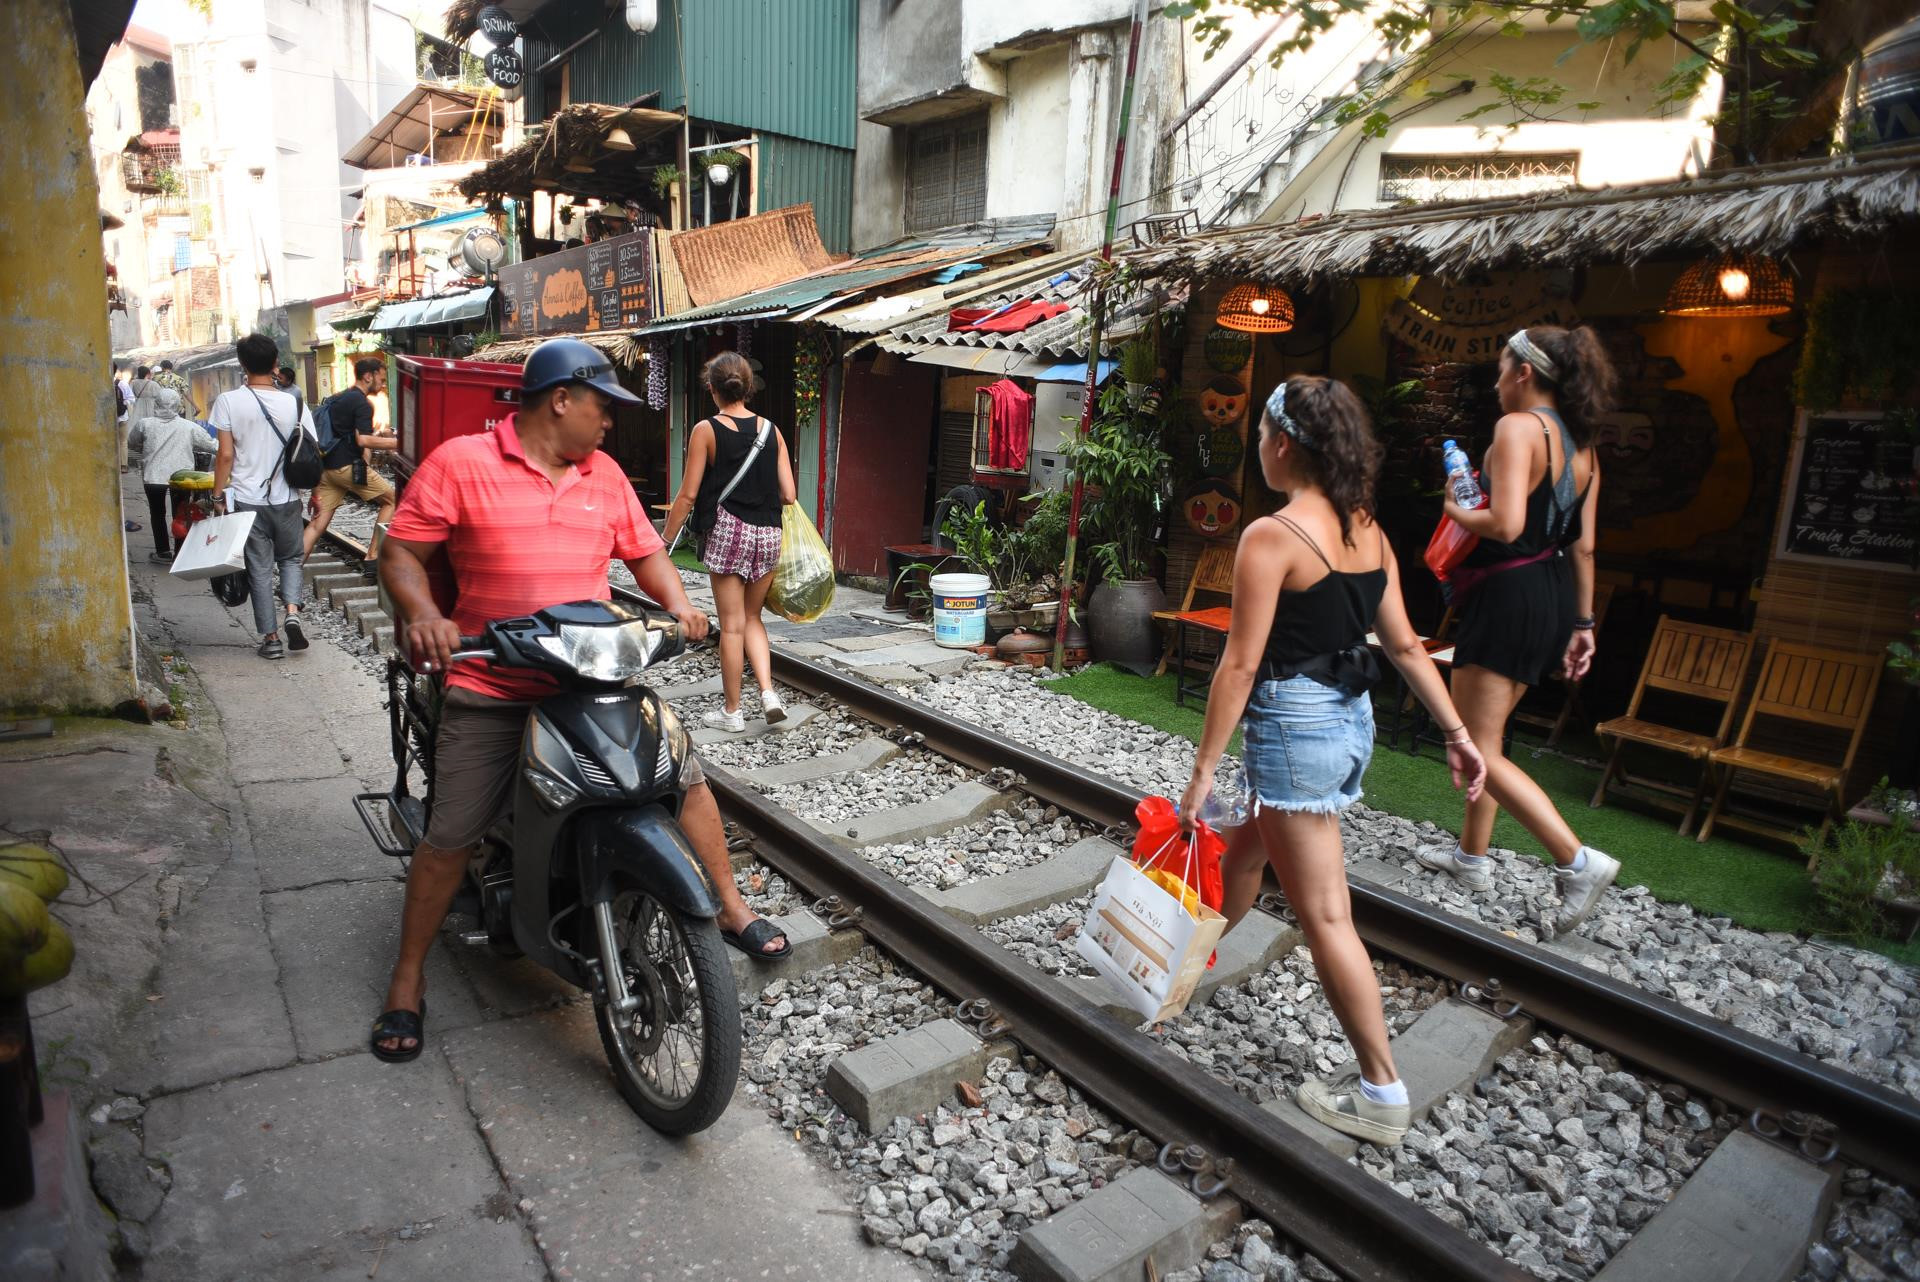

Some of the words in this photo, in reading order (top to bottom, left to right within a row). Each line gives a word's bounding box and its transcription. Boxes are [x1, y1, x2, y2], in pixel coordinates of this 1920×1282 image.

[483, 18, 517, 33] DRINKS
[492, 53, 518, 69] FAST
[493, 68, 520, 83] FOOD
[1399, 314, 1457, 354] TRAIN
[1796, 524, 1844, 543] Train
[1849, 529, 1916, 549] Station
[952, 600, 976, 608] JOTUN
